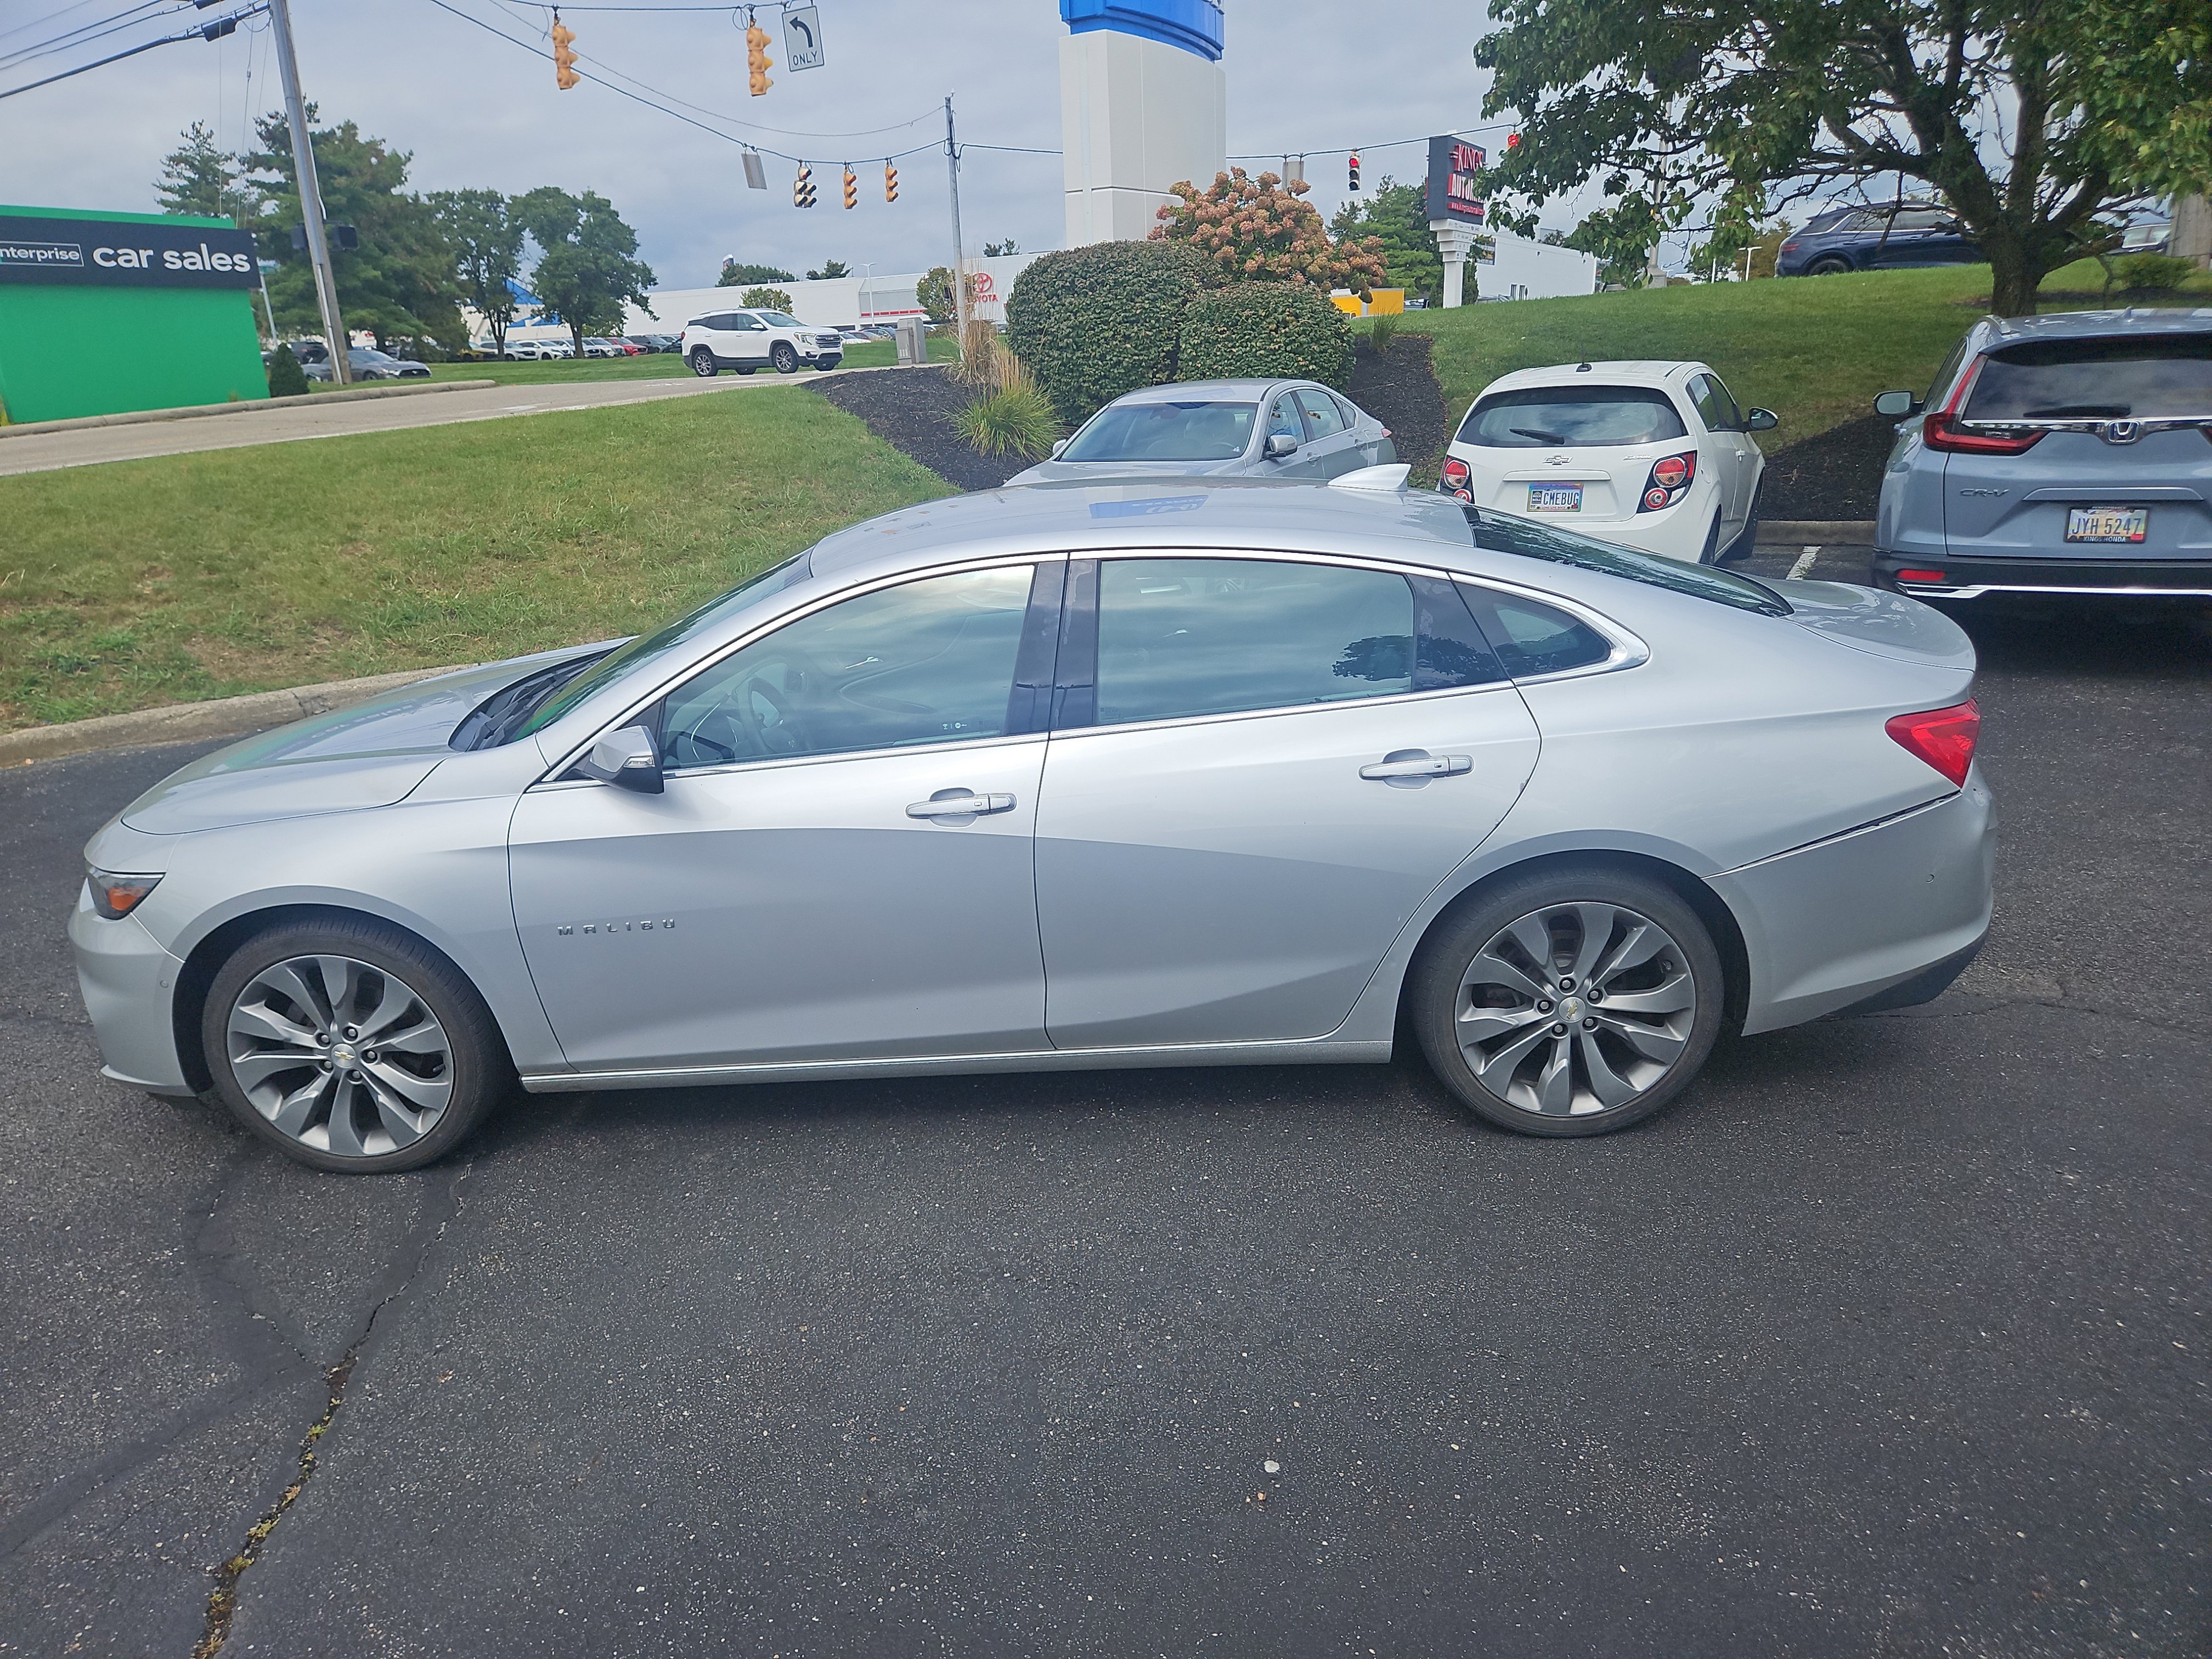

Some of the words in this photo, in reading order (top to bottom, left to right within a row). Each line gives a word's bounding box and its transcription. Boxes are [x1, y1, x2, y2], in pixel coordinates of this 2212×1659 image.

[793, 50, 817, 66] ONLY
[0, 247, 80, 262] nterprise
[93, 247, 154, 268] car
[163, 243, 251, 272] sales
[1543, 492, 1579, 505] CMEBUG
[1960, 488, 2009, 497] CR-V
[2072, 518, 2099, 534] JYH
[2104, 518, 2141, 534] 5247
[557, 919, 675, 935] MALIBU
